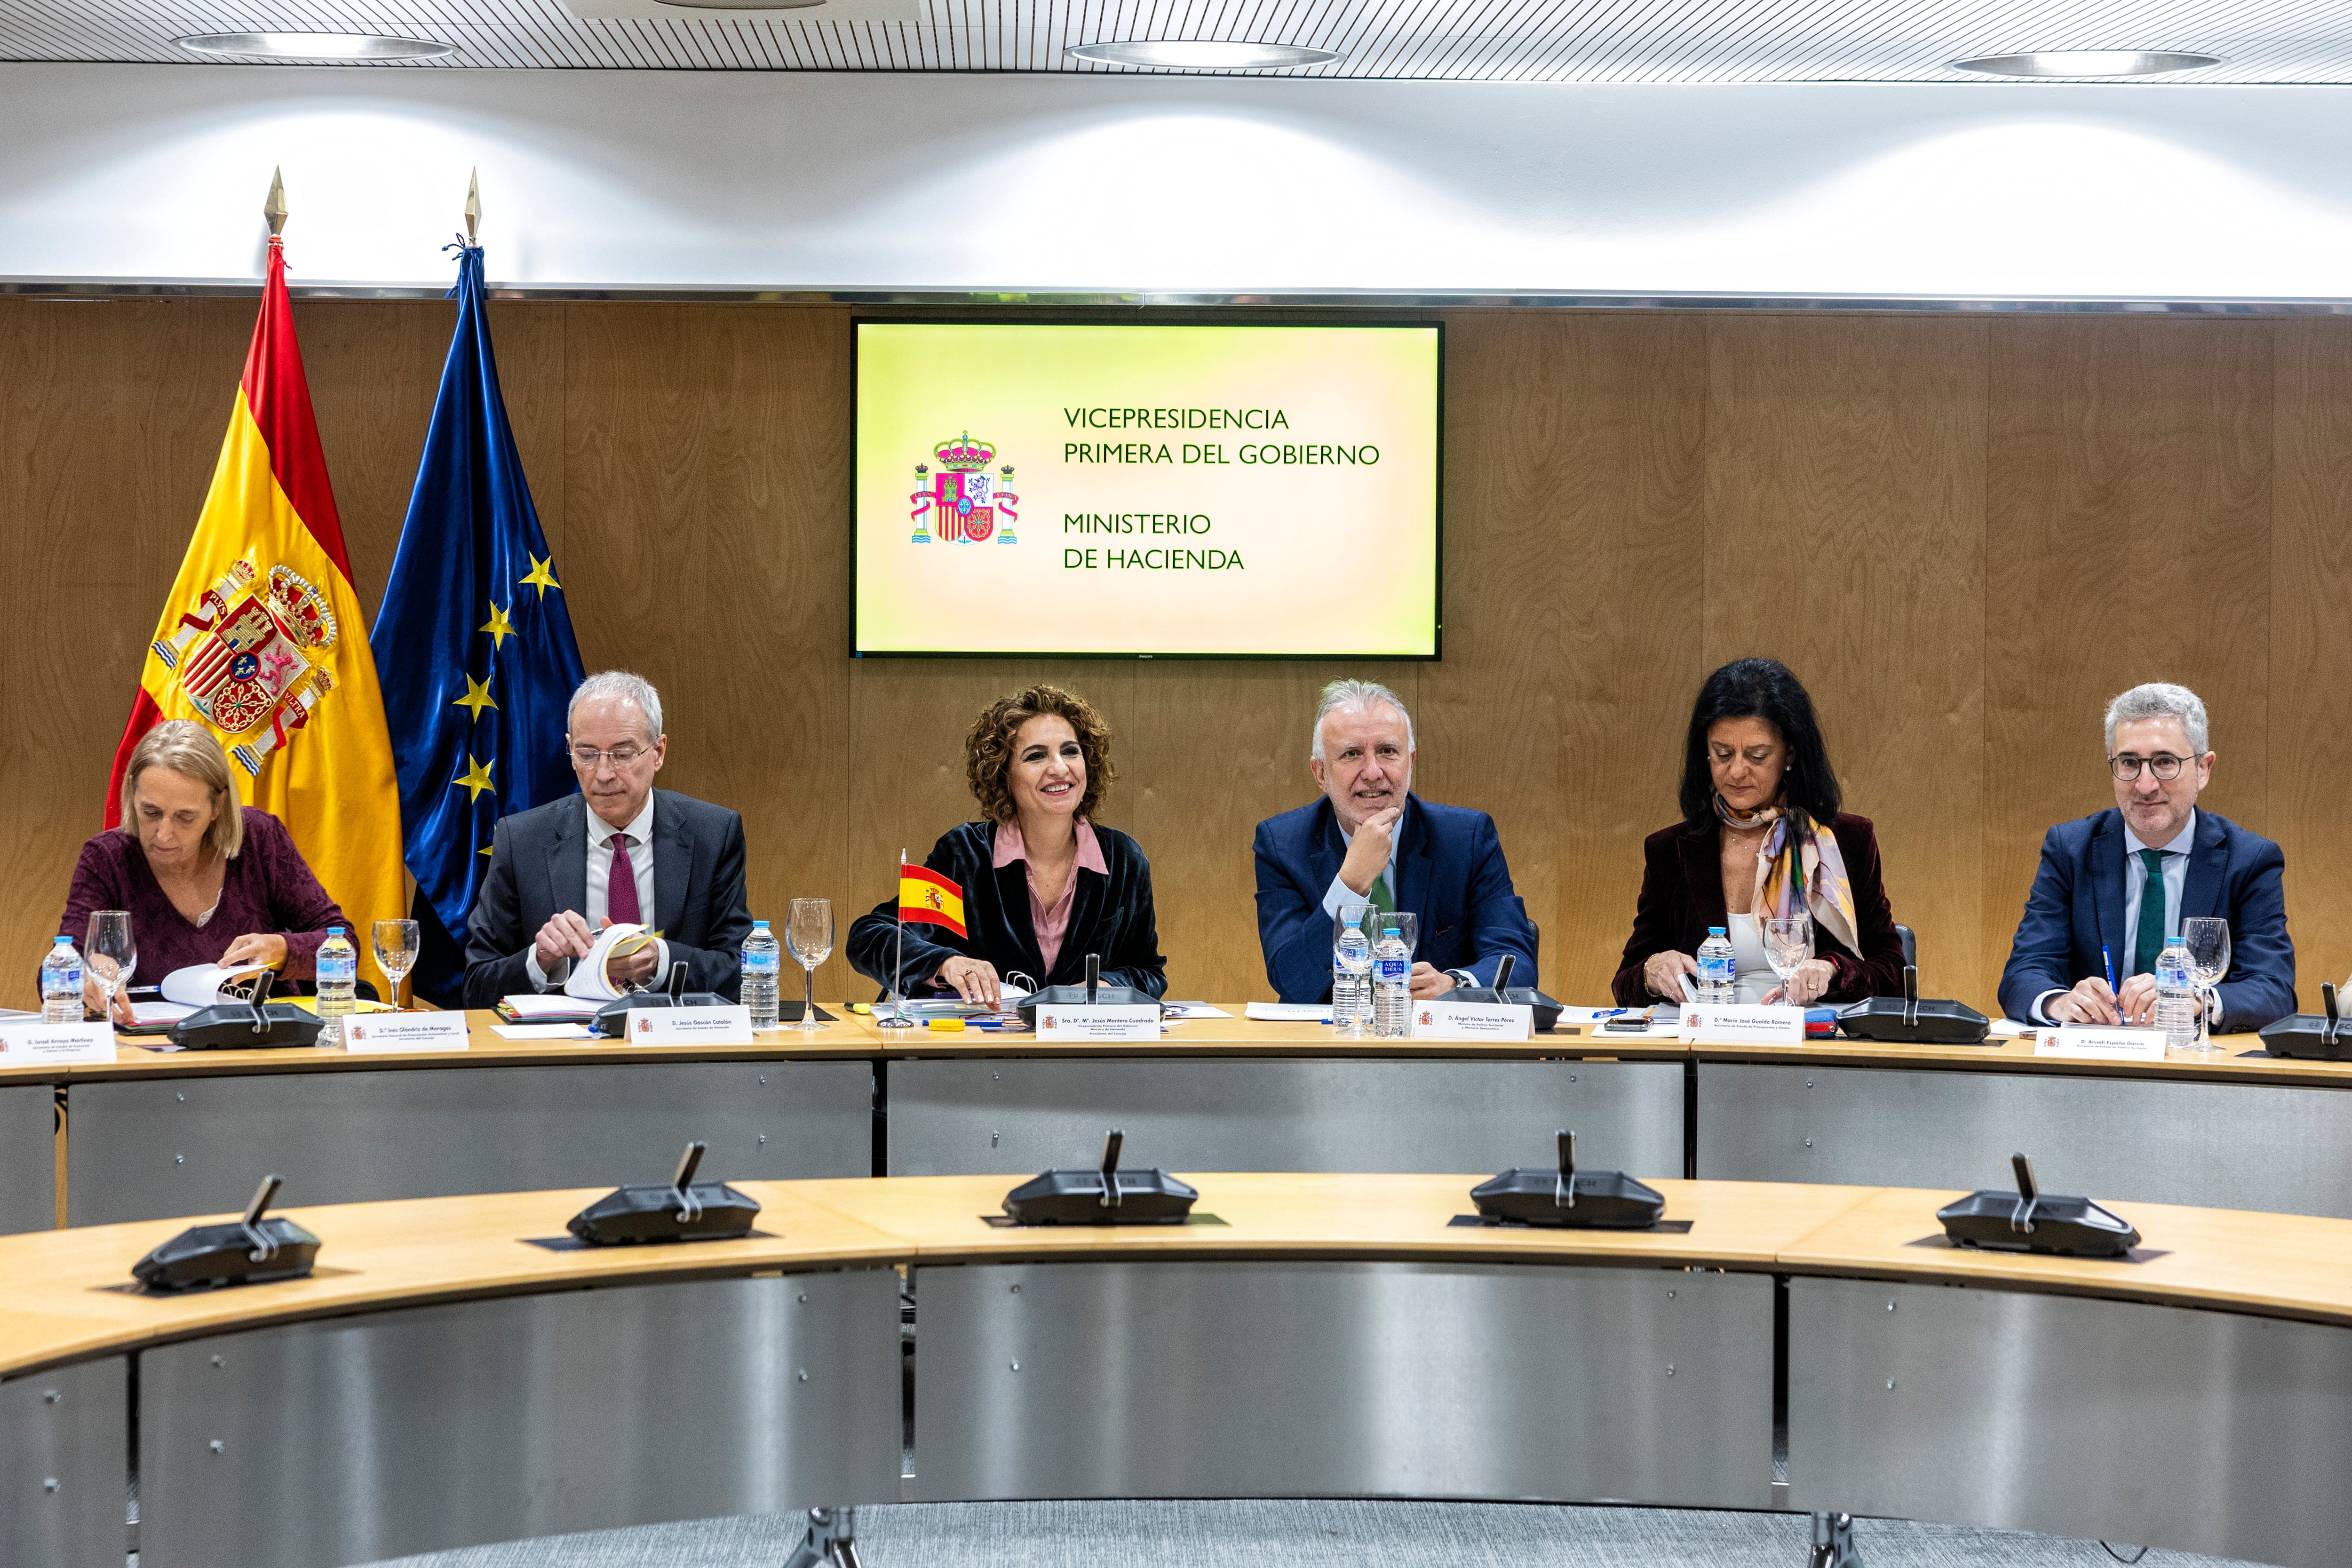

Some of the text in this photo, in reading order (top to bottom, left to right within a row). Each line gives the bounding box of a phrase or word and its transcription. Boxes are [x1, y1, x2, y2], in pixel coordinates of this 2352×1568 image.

[1064, 408, 1289, 429] VICEPRESIDENCIA
[1065, 443, 1380, 465] PRIMERA DEL GOBIERNO
[1065, 514, 1211, 534] MINISTERIO
[1065, 549, 1245, 570] DE HACIENDA
[209, 593, 226, 614] PLVS
[285, 692, 305, 718] VLTRA
